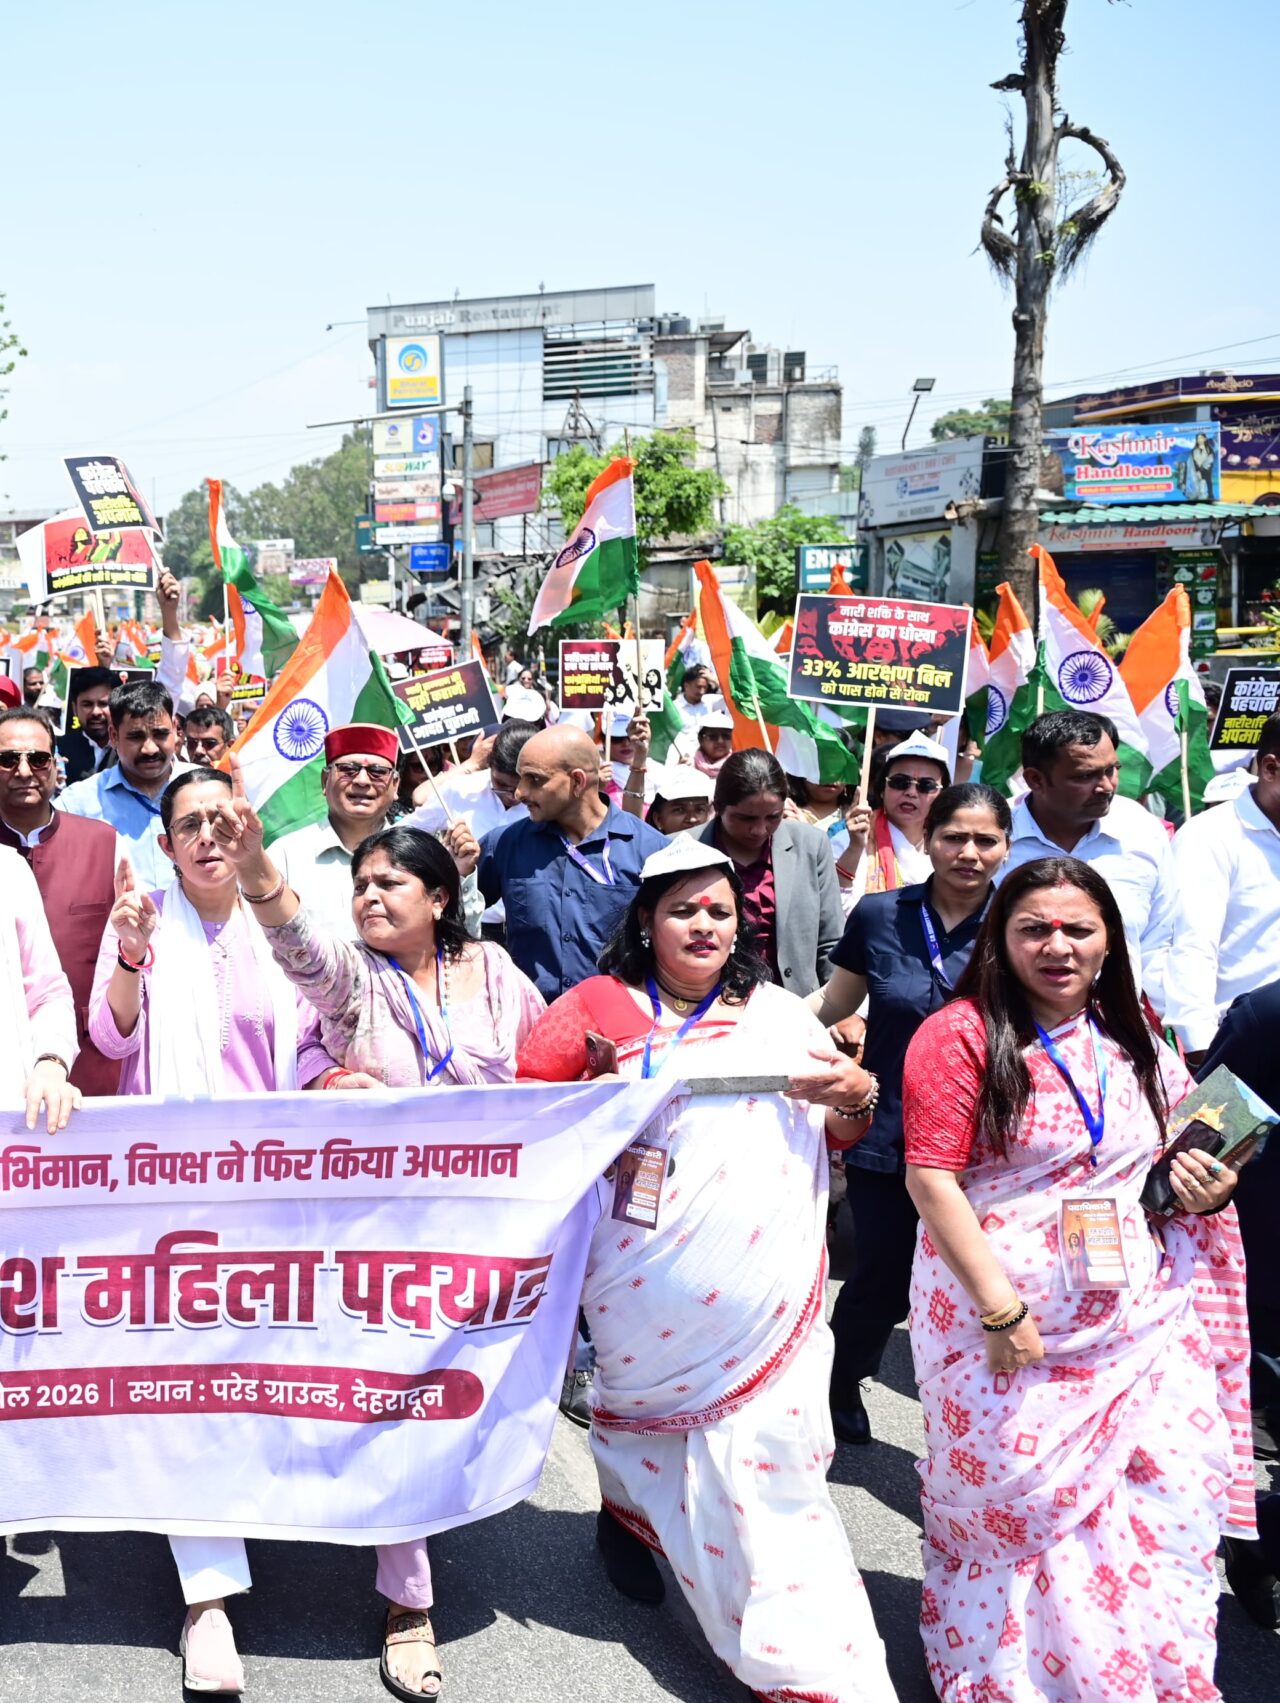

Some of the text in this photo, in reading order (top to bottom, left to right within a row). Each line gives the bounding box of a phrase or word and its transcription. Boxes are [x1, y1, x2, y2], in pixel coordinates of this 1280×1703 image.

[393, 309, 455, 329] Punjab
[1068, 431, 1178, 465] Kashmir
[1076, 465, 1173, 481] Handloom
[1048, 524, 1196, 543] Kashmir Handloom
[805, 548, 864, 570] ENTRY
[839, 604, 931, 627] नारी शक्ति के साथ
[828, 618, 938, 645] कांग्रेस का धोखा
[801, 658, 955, 689] 33% आरक्षण बिल
[821, 680, 932, 704] को पास होने से रोका
[1234, 676, 1280, 698] कांग्रेस
[1230, 696, 1279, 713] पहचान
[1218, 729, 1263, 744] अपमा
[124, 1142, 212, 1187] विपक्ष
[215, 1140, 249, 1183] ने
[251, 1138, 317, 1183] फिर
[319, 1137, 399, 1181] किया
[403, 1142, 523, 1180] अपमान
[77, 1230, 325, 1330] महिला
[36, 1383, 100, 1409] 2026
[128, 1379, 194, 1404] स्थान
[211, 1371, 258, 1403] परेड
[264, 1379, 345, 1413] ग्राउन्ड,
[350, 1378, 444, 1419] देहरादून
